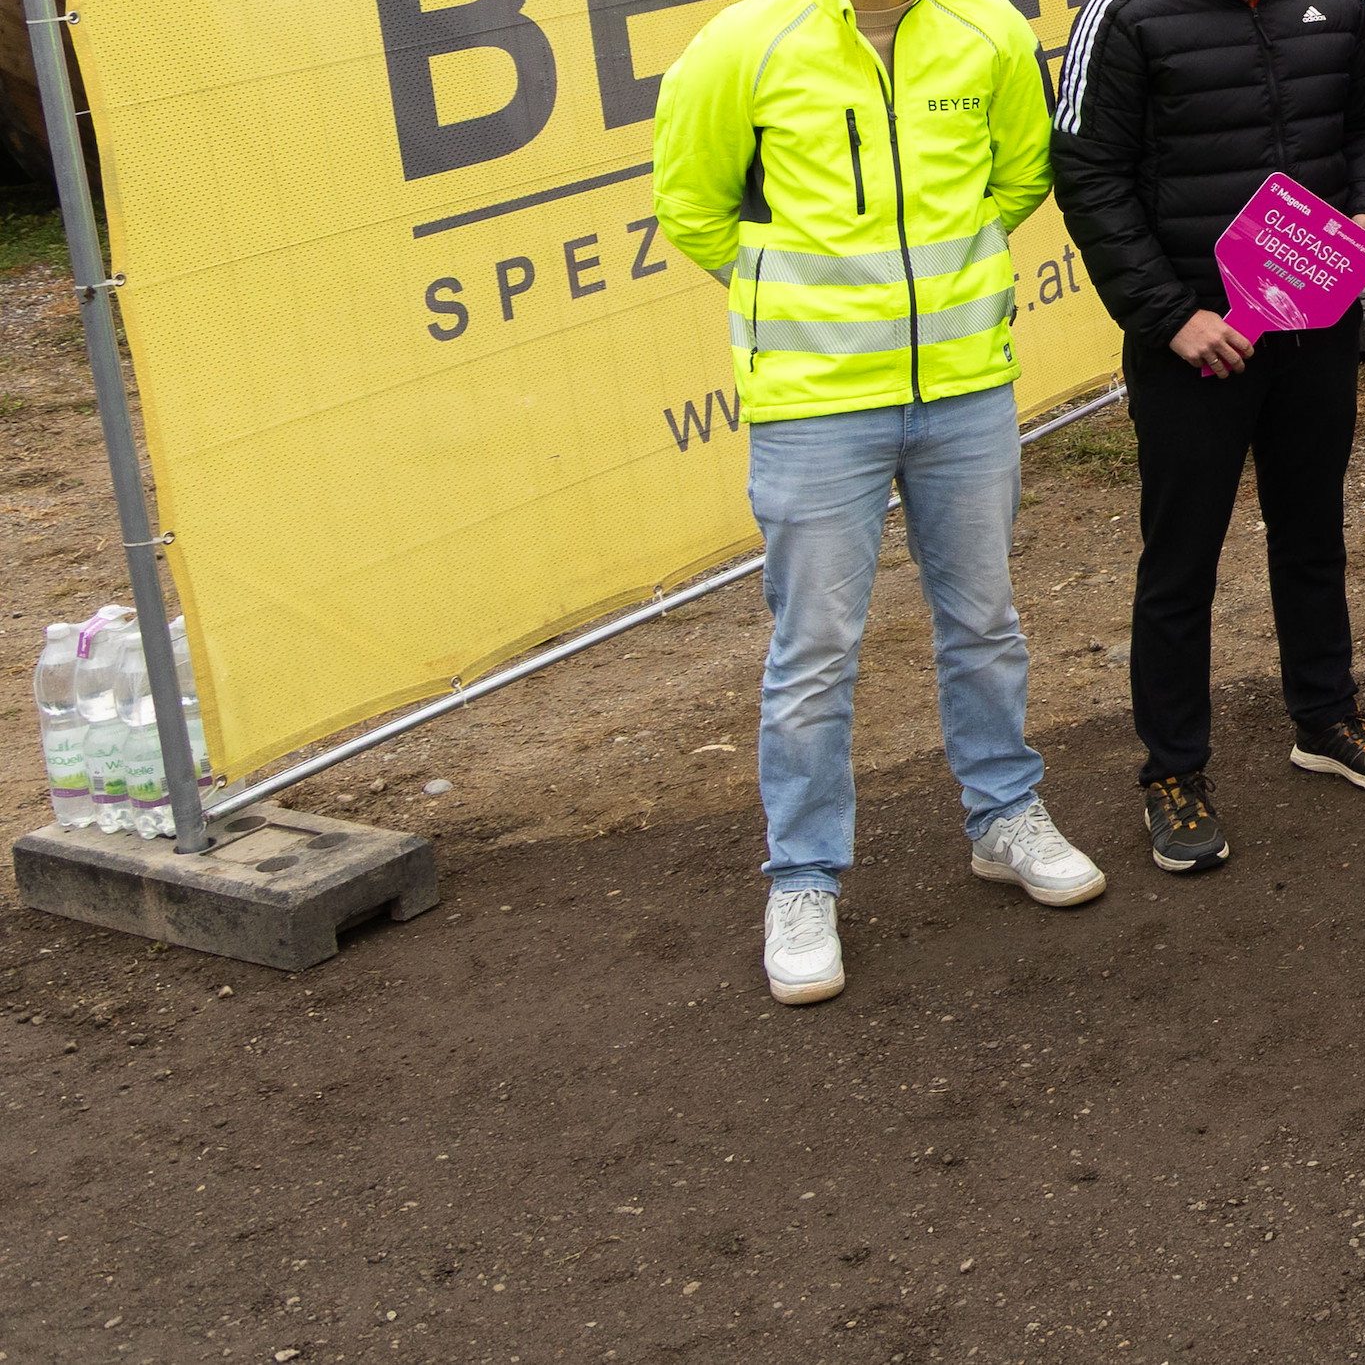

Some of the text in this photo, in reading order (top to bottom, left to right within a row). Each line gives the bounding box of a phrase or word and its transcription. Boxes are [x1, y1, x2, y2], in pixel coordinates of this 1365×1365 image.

[1302, 14, 1327, 23] adidas
[928, 97, 980, 111] BEYER
[1277, 187, 1312, 216] Magenta
[1264, 209, 1354, 274] GLASFASER-
[1255, 227, 1338, 292] ÜBERGABE
[1263, 259, 1306, 290] BITTE HIER
